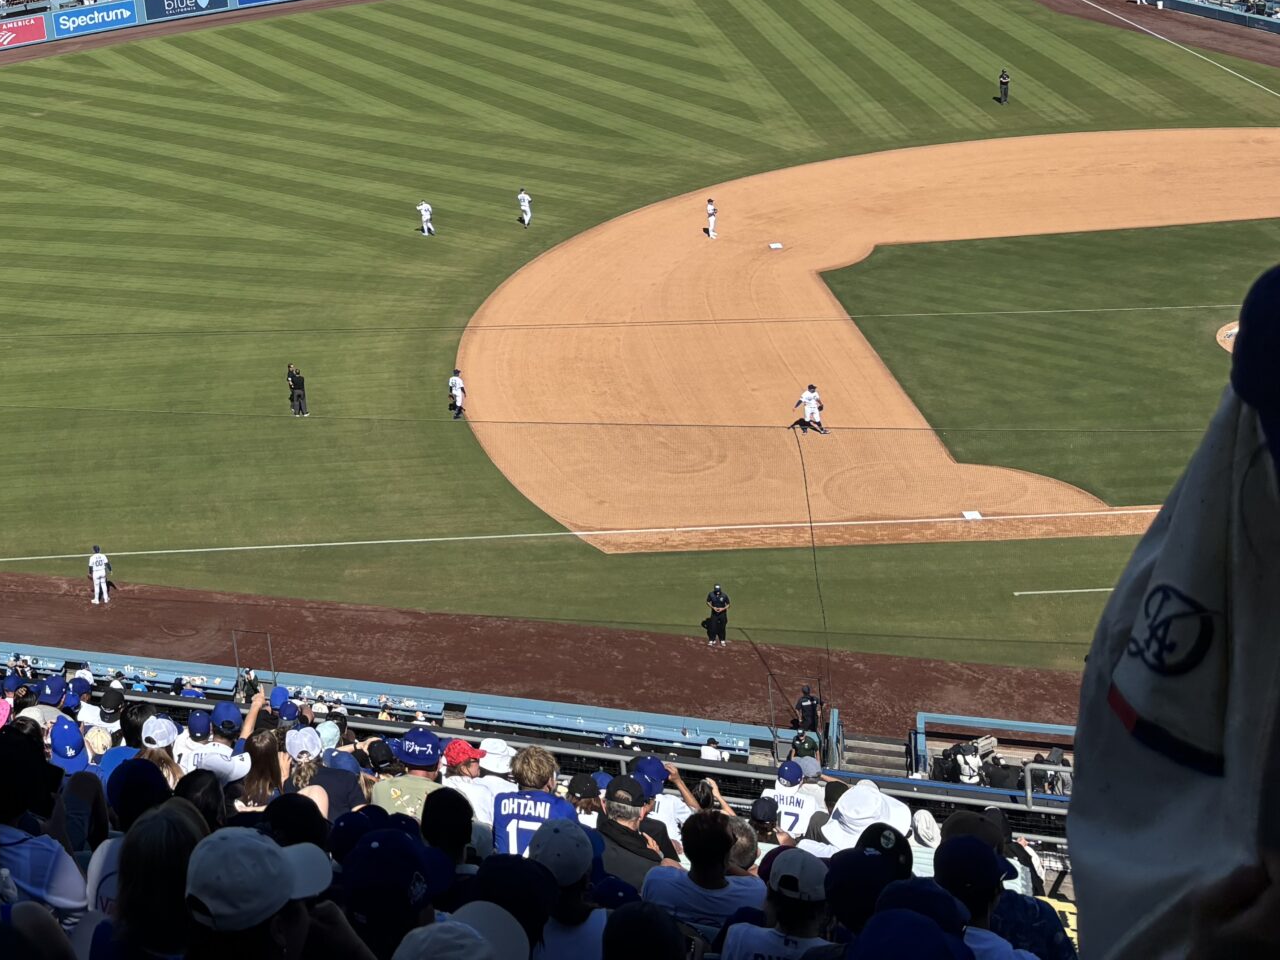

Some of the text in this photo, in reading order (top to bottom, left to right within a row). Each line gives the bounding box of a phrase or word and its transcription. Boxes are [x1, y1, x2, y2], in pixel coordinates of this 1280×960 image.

[166, 6, 196, 14] CALIFORNIA
[5, 19, 35, 30] AMERICA
[60, 8, 124, 32] Spectrum
[65, 745, 76, 757] LA
[405, 740, 433, 754] ドジャース
[501, 798, 550, 819] OHTANI
[506, 819, 542, 859] 17
